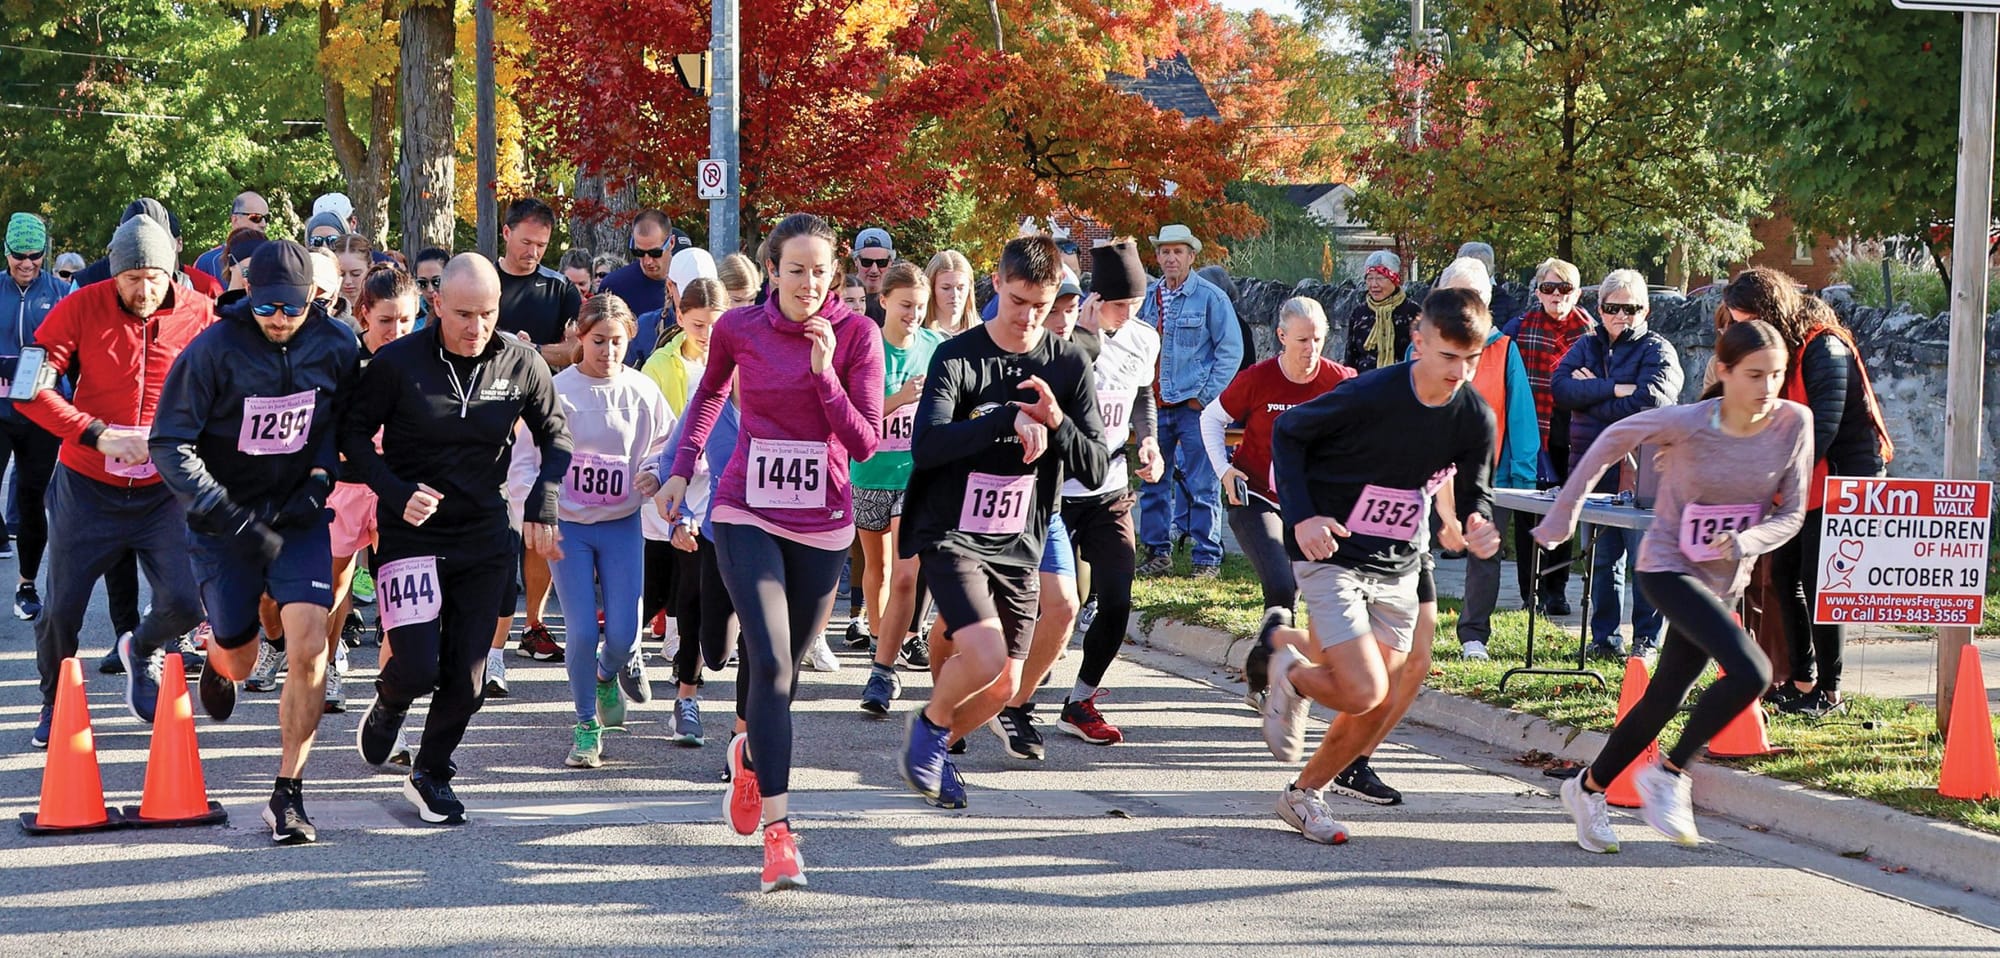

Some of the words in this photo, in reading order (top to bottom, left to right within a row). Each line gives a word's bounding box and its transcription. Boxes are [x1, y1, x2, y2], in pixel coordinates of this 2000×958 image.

[1267, 403, 1285, 412] you
[251, 408, 307, 440] 1294
[572, 466, 624, 497] 1380
[756, 456, 818, 491] 1445
[1933, 483, 1976, 498] RUN
[972, 488, 1023, 518] 1351
[1361, 498, 1420, 528] 1352
[1933, 502, 1974, 516] WALK
[1826, 518, 1877, 537] RACE
[1884, 519, 1984, 540] CHILDREN
[1914, 542, 1935, 557] OF
[1940, 543, 1983, 558] HAITI
[1868, 567, 1953, 587] OCTOBER
[1959, 568, 1979, 588] 19
[381, 573, 434, 612] 1444
[1825, 594, 1975, 610] www.StAndrewsFergus.org
[1831, 608, 1848, 621] Or
[1851, 607, 1874, 621] Call
[1878, 608, 1967, 623] 519-843-3565
